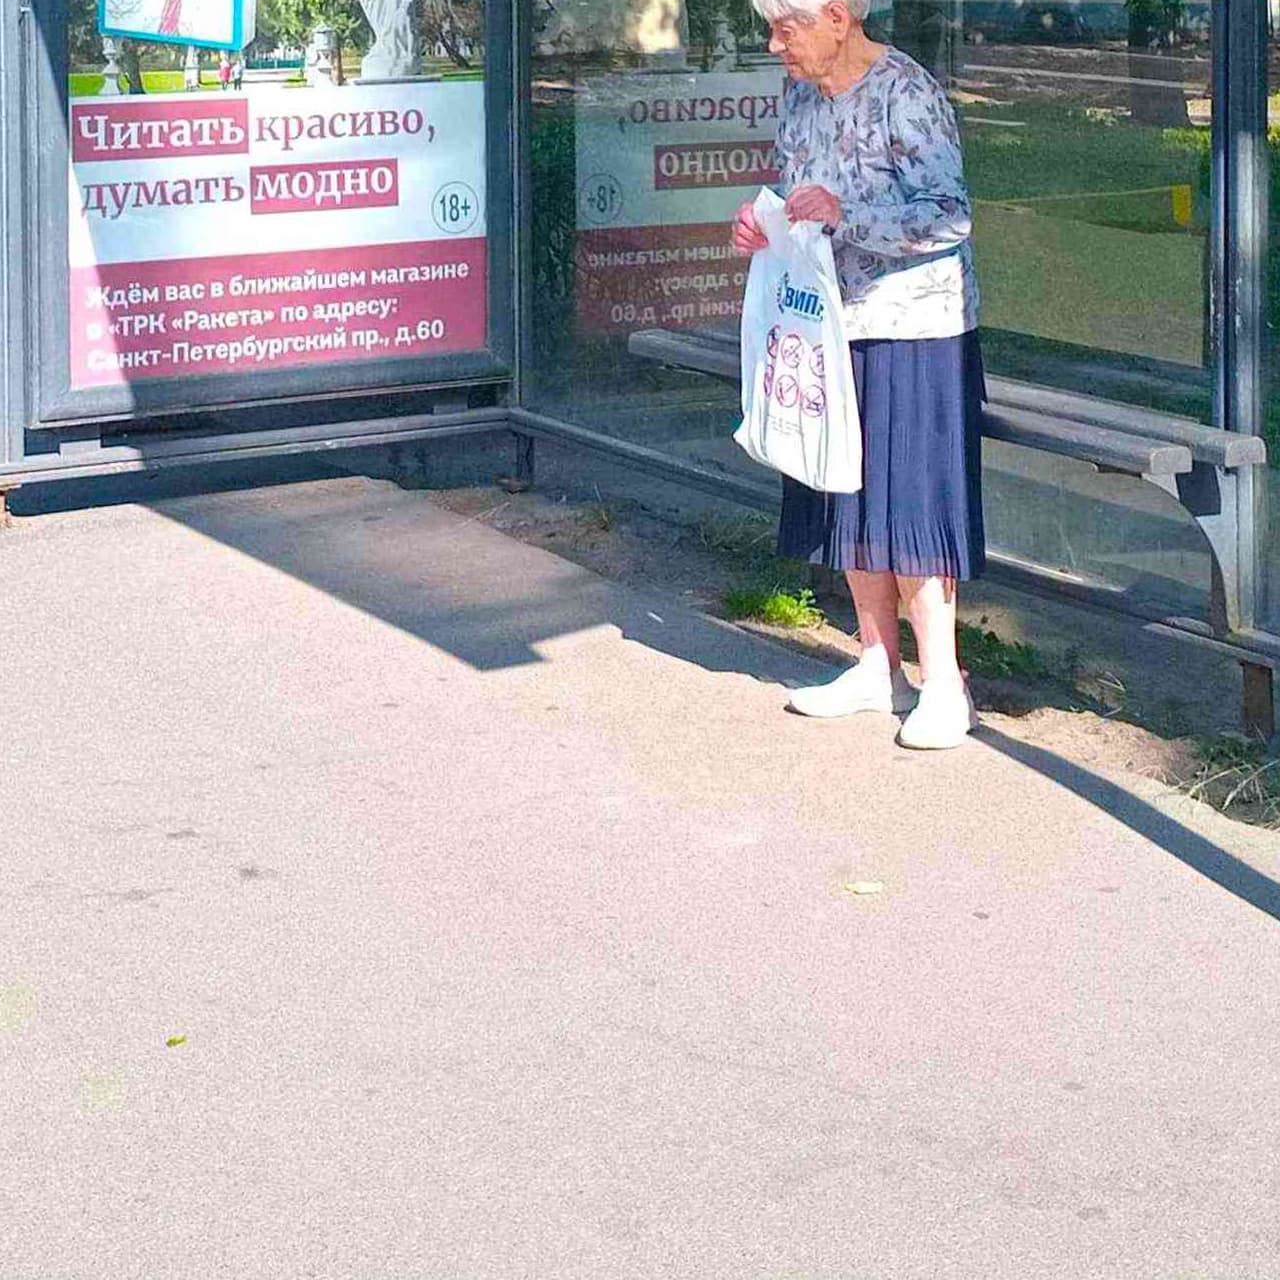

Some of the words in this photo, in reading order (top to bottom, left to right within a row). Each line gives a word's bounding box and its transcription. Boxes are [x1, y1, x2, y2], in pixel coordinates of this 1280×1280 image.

[77, 115, 245, 151] Читать
[254, 108, 435, 151] красиво,
[81, 176, 246, 220] думать
[253, 166, 393, 206] модно
[439, 193, 471, 223] 18+
[85, 282, 159, 310] Ждём
[165, 282, 205, 302] вас
[210, 281, 224, 298] в
[229, 269, 366, 297] ближайшем
[371, 261, 469, 285] магазине
[108, 313, 167, 337] «ТРК
[172, 309, 275, 331] «Ракета»
[280, 305, 308, 323] по
[312, 297, 398, 322] адресу:
[86, 326, 346, 370] Санкт-Петербургский
[351, 328, 390, 351] пр.,
[394, 319, 445, 346] д.60
